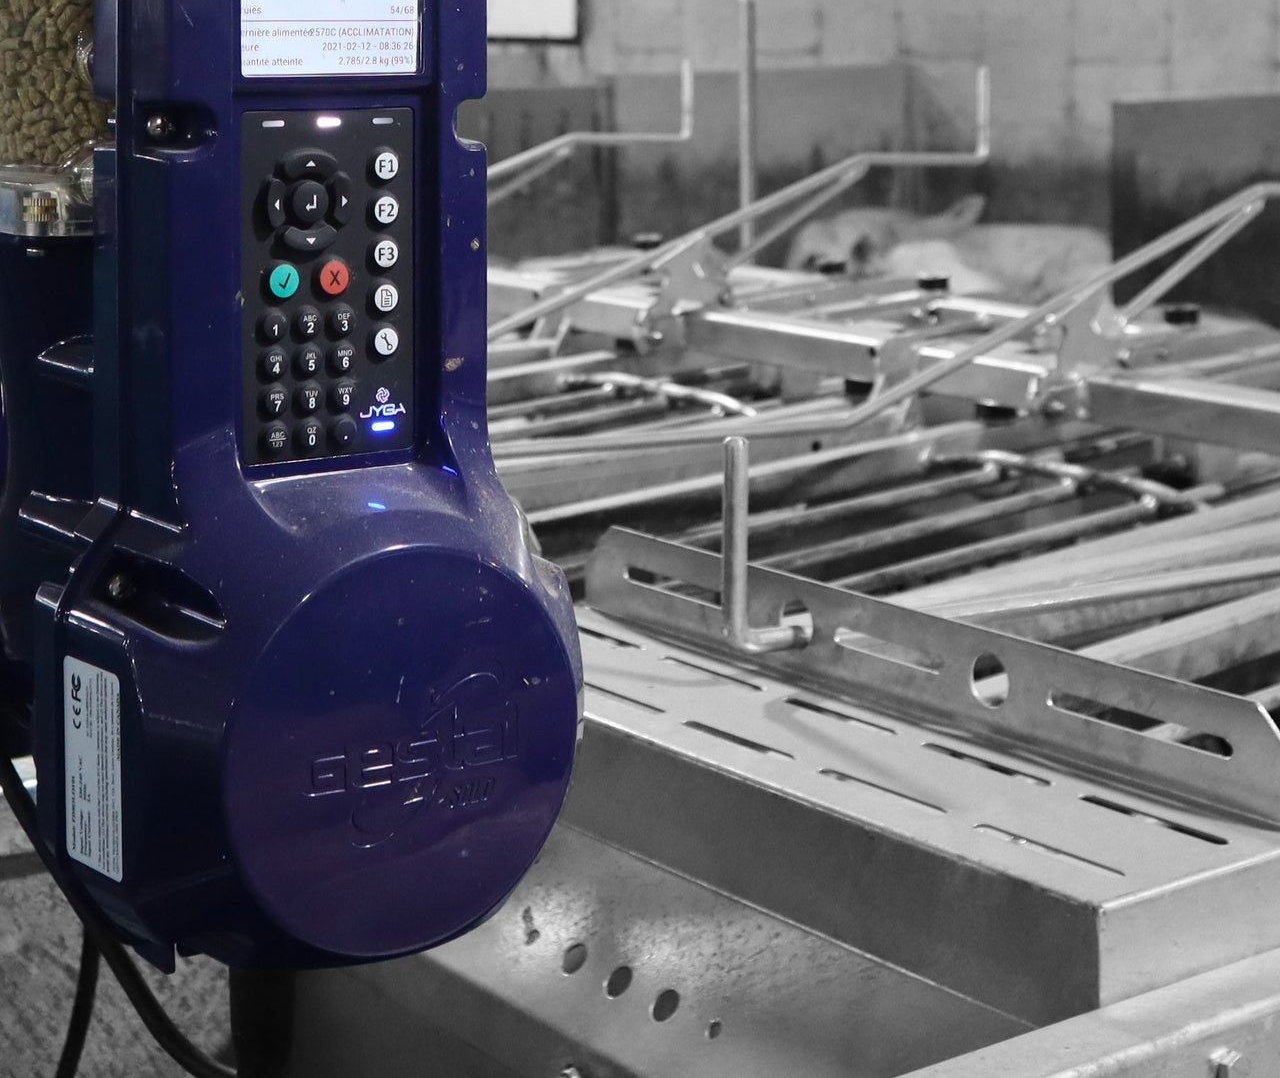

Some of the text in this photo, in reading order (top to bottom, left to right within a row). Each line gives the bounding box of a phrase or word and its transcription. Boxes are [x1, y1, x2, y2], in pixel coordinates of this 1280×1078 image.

[338, 27, 414, 38] (ACCLIMATATION)
[322, 41, 371, 51] 2021-02-12
[271, 57, 303, 66] atteinte
[380, 56, 389, 67] kg
[378, 159, 395, 174] F1
[378, 204, 395, 218] F2
[378, 247, 395, 261] F3
[303, 314, 317, 322] ABC
[337, 312, 351, 320] DEF
[272, 324, 278, 336] 1
[306, 322, 314, 334] 2
[341, 320, 349, 332] 3
[305, 352, 317, 360] JKL
[337, 349, 353, 357] MNO
[308, 360, 316, 371] 5
[342, 357, 350, 368] 6
[272, 363, 280, 374] 4
[270, 393, 285, 401] PRS
[305, 390, 318, 398] TUV
[342, 394, 350, 405] 9
[274, 401, 282, 412] 7
[308, 397, 316, 409] 8
[359, 402, 407, 419] JYGA
[270, 431, 285, 439] ABC
[307, 426, 317, 434] QZ
[308, 434, 316, 446] 0
